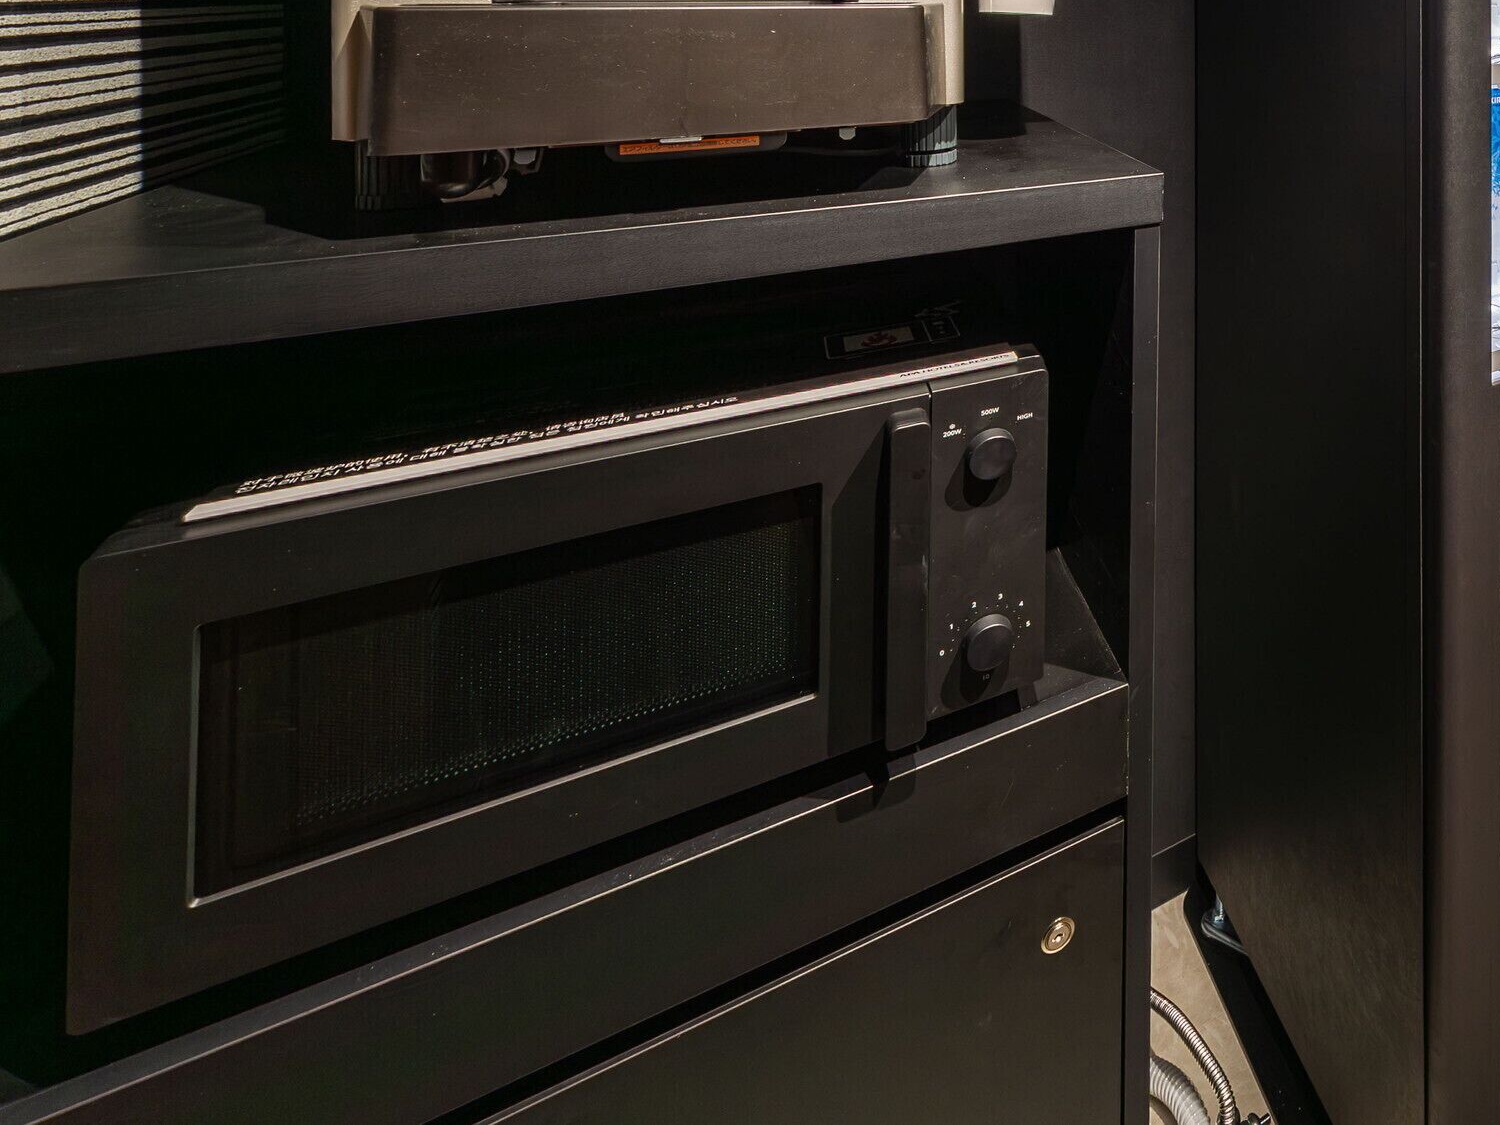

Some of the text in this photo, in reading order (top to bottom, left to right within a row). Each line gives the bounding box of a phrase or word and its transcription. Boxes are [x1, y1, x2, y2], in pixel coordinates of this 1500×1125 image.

[981, 406, 999, 417] 500W
[1017, 412, 1033, 421] HIGH
[943, 428, 962, 438] 200W
